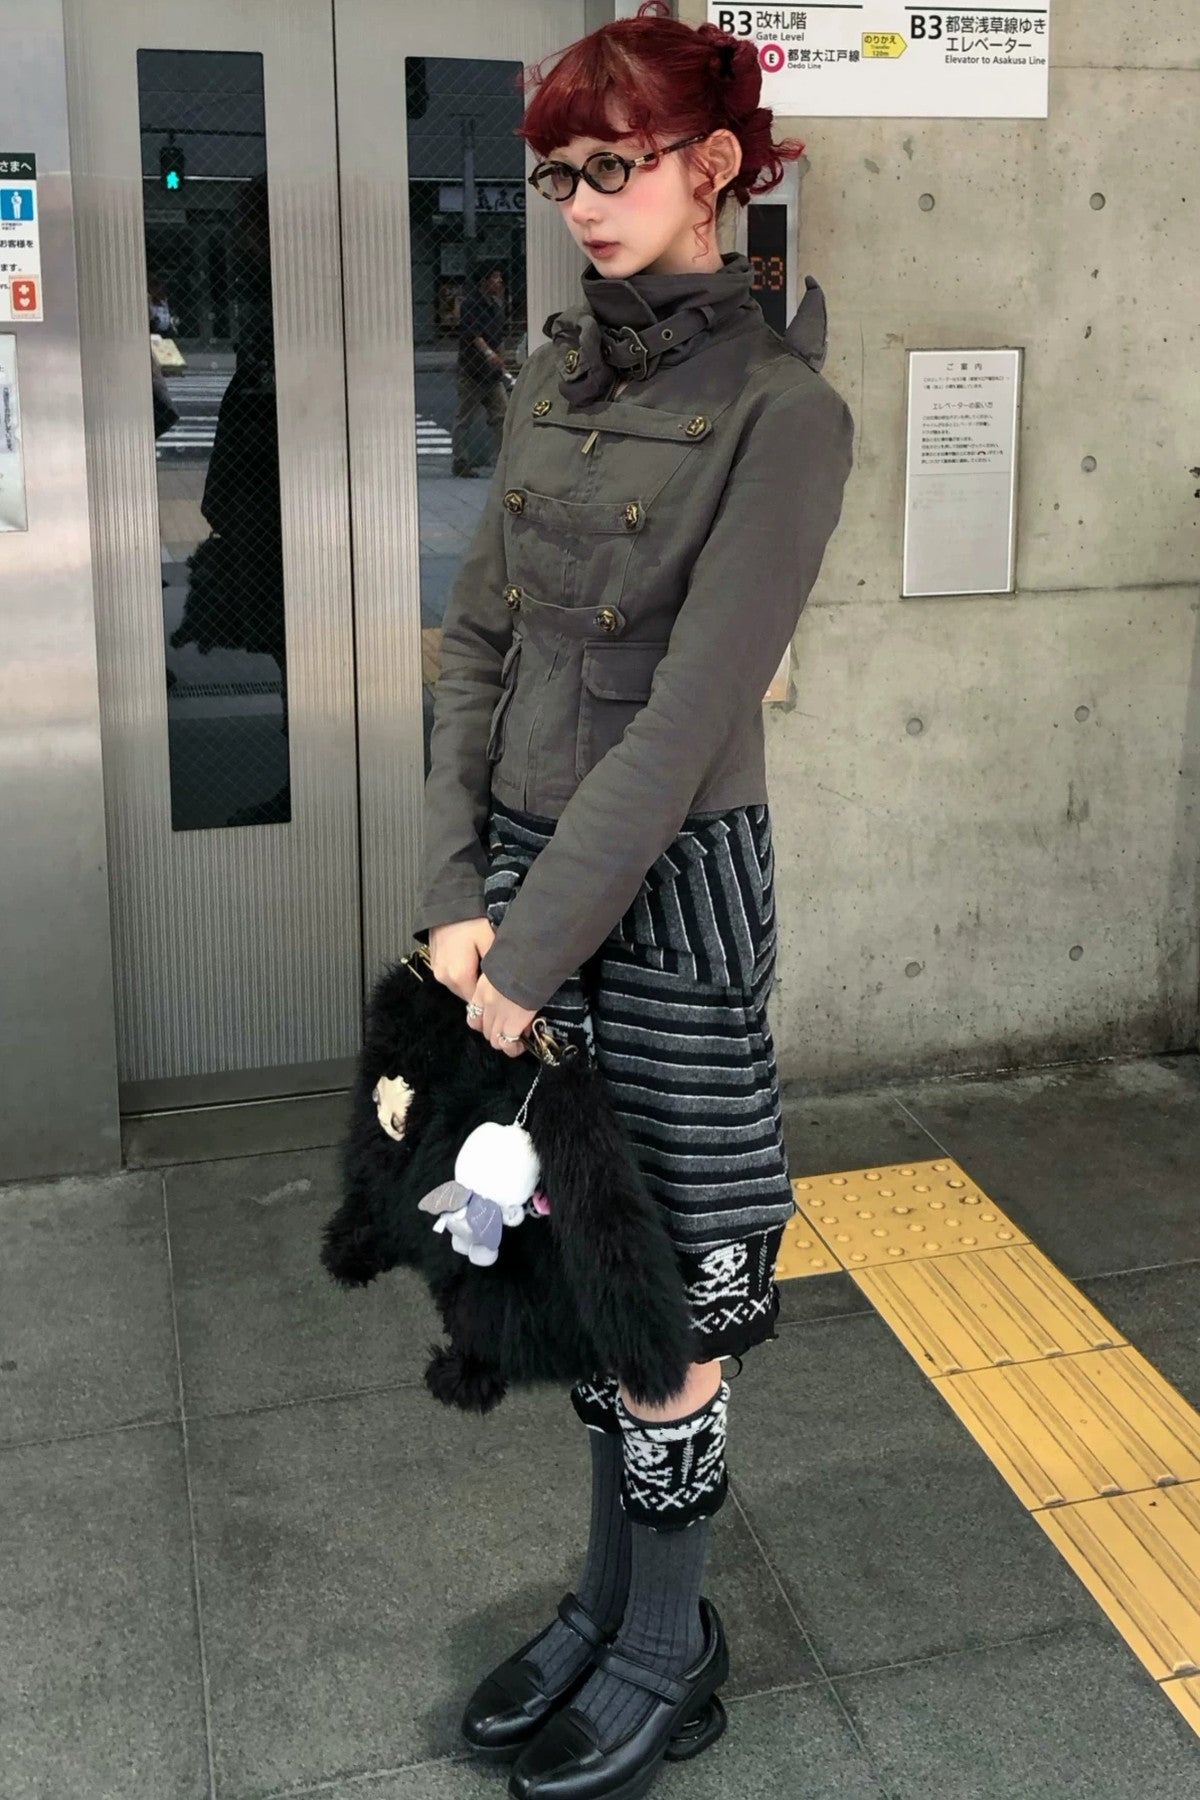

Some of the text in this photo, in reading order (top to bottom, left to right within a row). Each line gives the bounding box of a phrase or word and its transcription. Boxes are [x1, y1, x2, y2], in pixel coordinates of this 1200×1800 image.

[718, 10, 807, 36] B3 改札階
[911, 15, 1046, 39] B3 都営浅草線ゆき
[756, 32, 805, 41] Gate Level
[864, 35, 897, 44] のりかえ
[946, 37, 1032, 53] エレベーター
[769, 54, 775, 63] E
[787, 49, 860, 62] 都営大江戸線
[945, 55, 1046, 65] Elevator to Asakusa Line
[0, 160, 32, 173] さまへ
